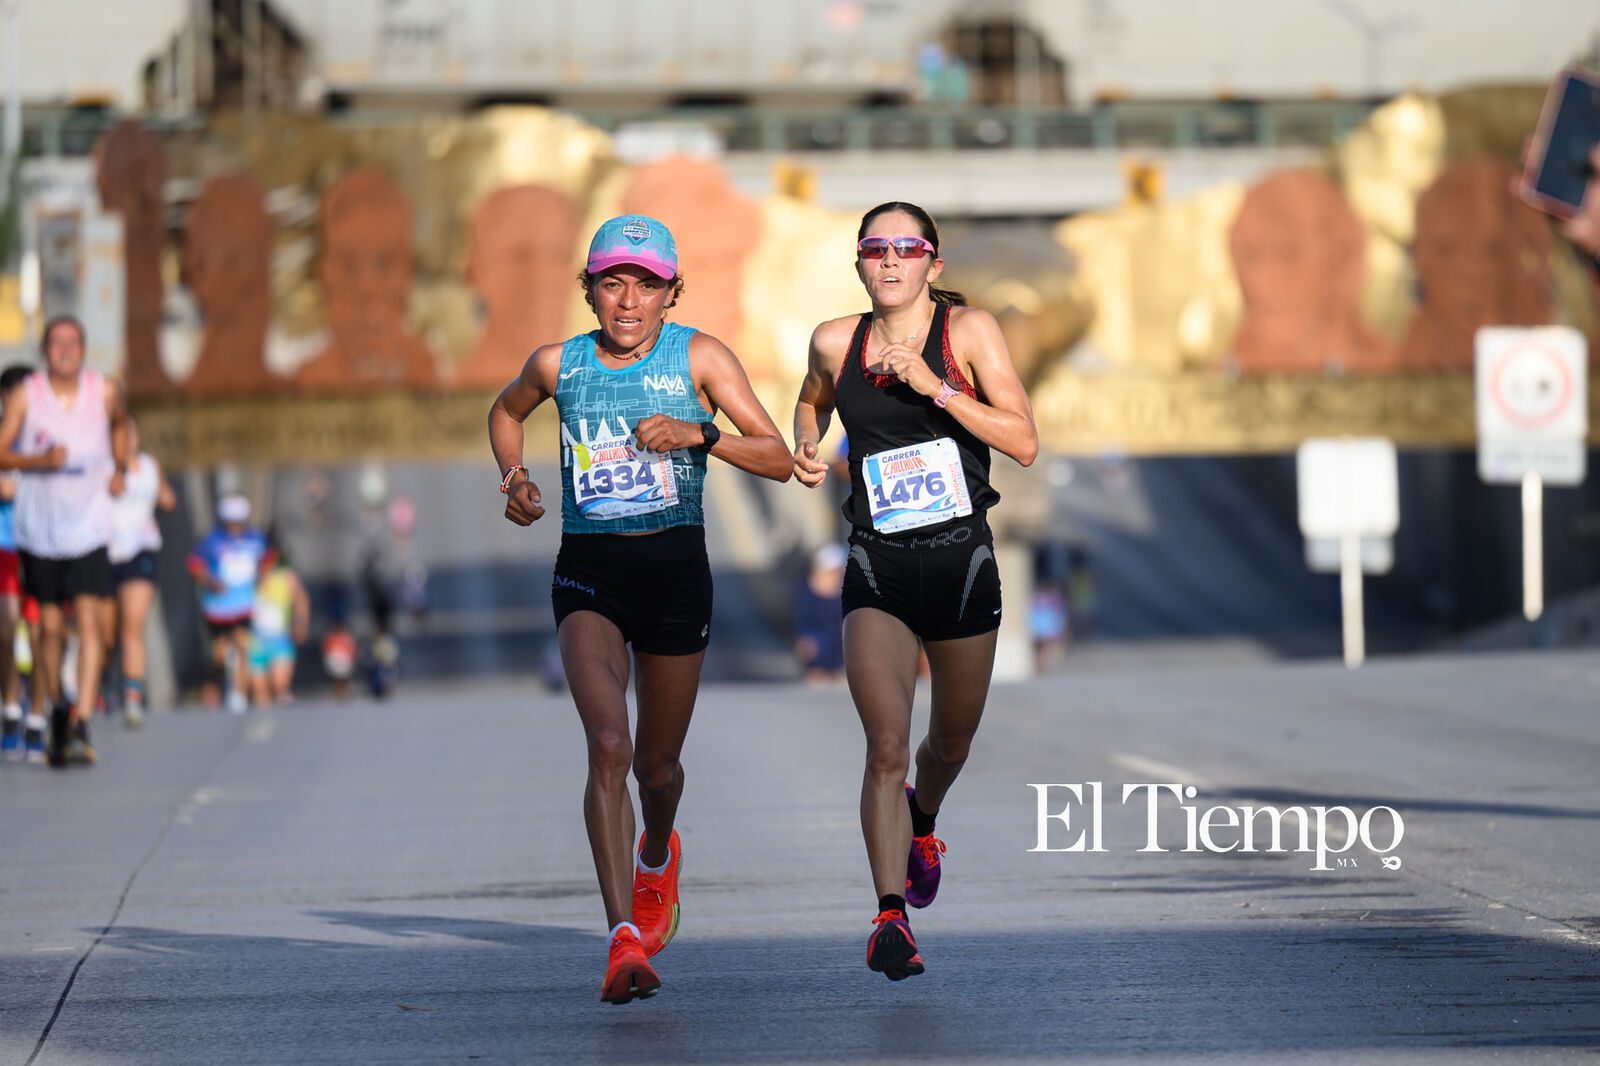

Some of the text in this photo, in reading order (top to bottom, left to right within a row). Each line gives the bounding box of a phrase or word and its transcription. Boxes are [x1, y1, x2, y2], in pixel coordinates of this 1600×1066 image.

[644, 374, 687, 391] NAVA
[591, 439, 632, 451] CARRERA
[882, 449, 921, 464] CARRERA
[579, 461, 656, 498] 1334
[873, 471, 946, 509] 1476
